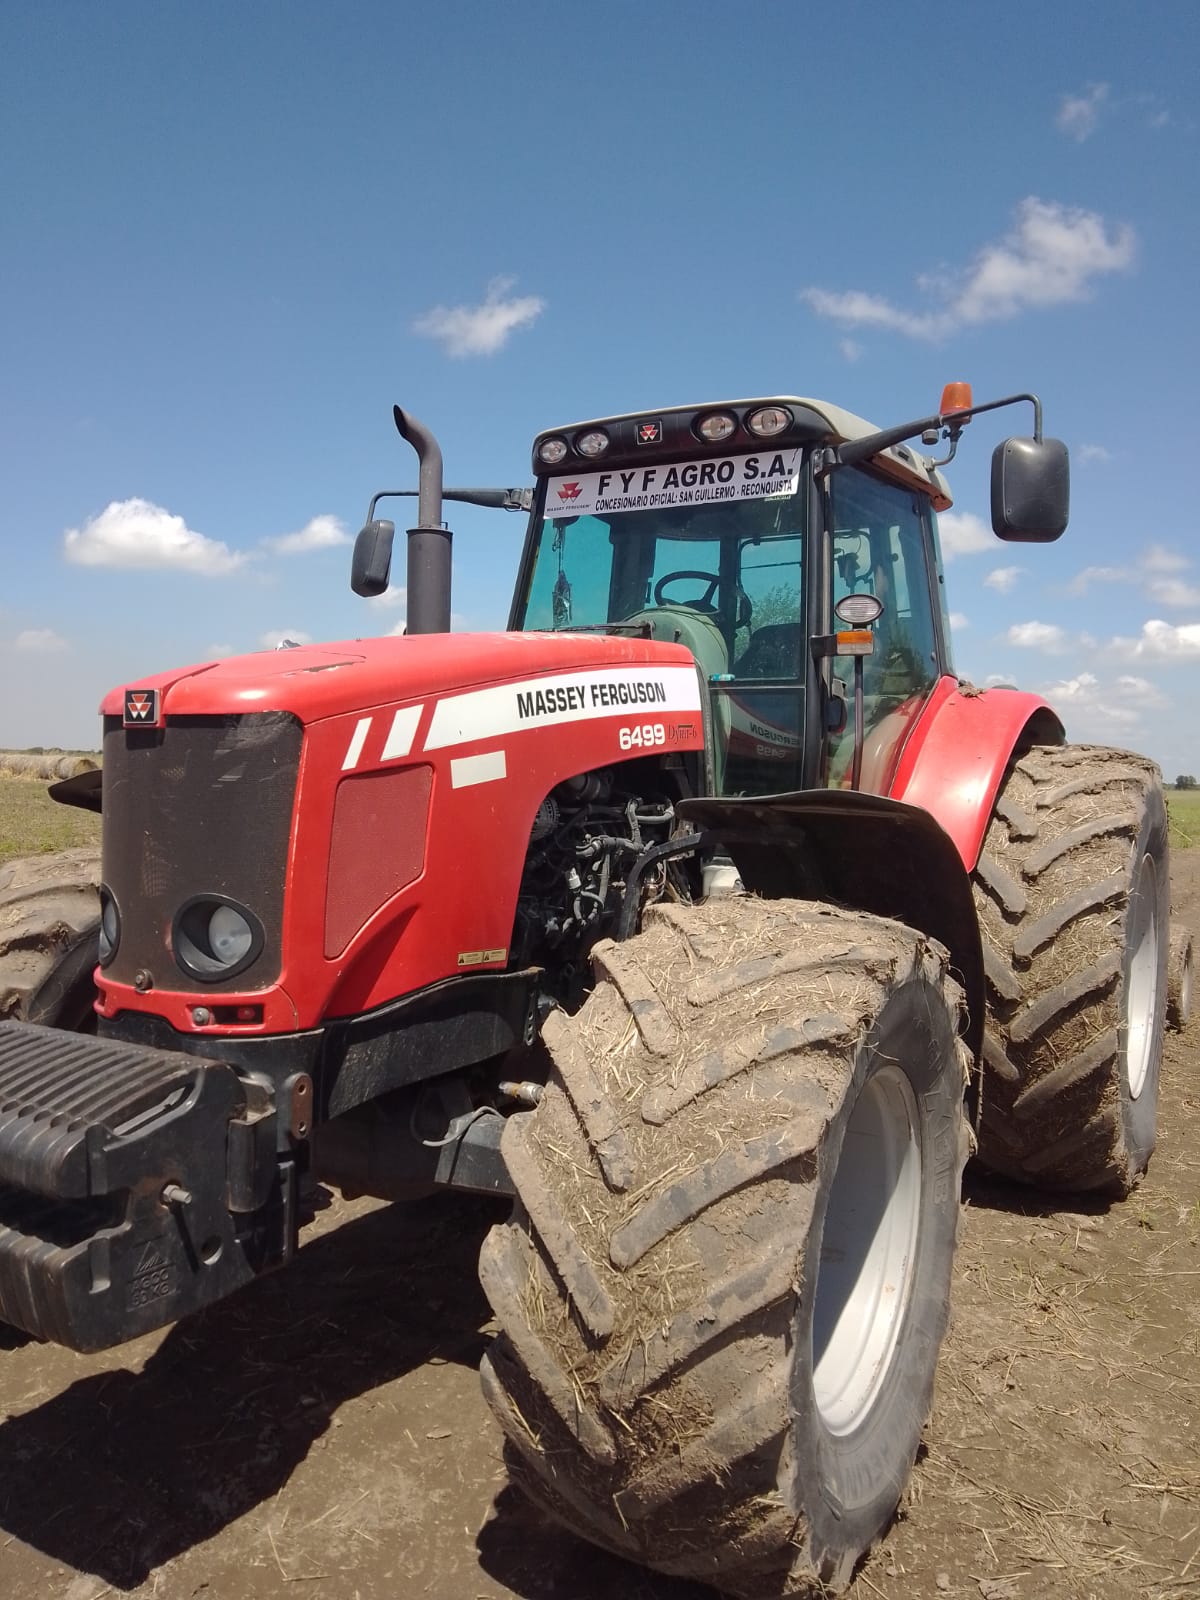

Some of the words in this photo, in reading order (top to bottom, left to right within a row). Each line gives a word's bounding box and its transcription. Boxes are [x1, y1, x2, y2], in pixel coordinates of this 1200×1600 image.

[598, 474, 612, 496] F
[620, 471, 636, 493] Y
[642, 469, 657, 491] F
[662, 460, 735, 489] AGRO
[743, 454, 793, 480] S.A.
[595, 494, 648, 512] CONCESIONARIO
[679, 488, 694, 503] SAN
[694, 485, 736, 502] GUILLERMO
[741, 478, 793, 497] RECONQUISTA
[516, 684, 587, 719] MASSEY
[591, 681, 667, 708] FERGUSON
[619, 723, 666, 750] 6499
